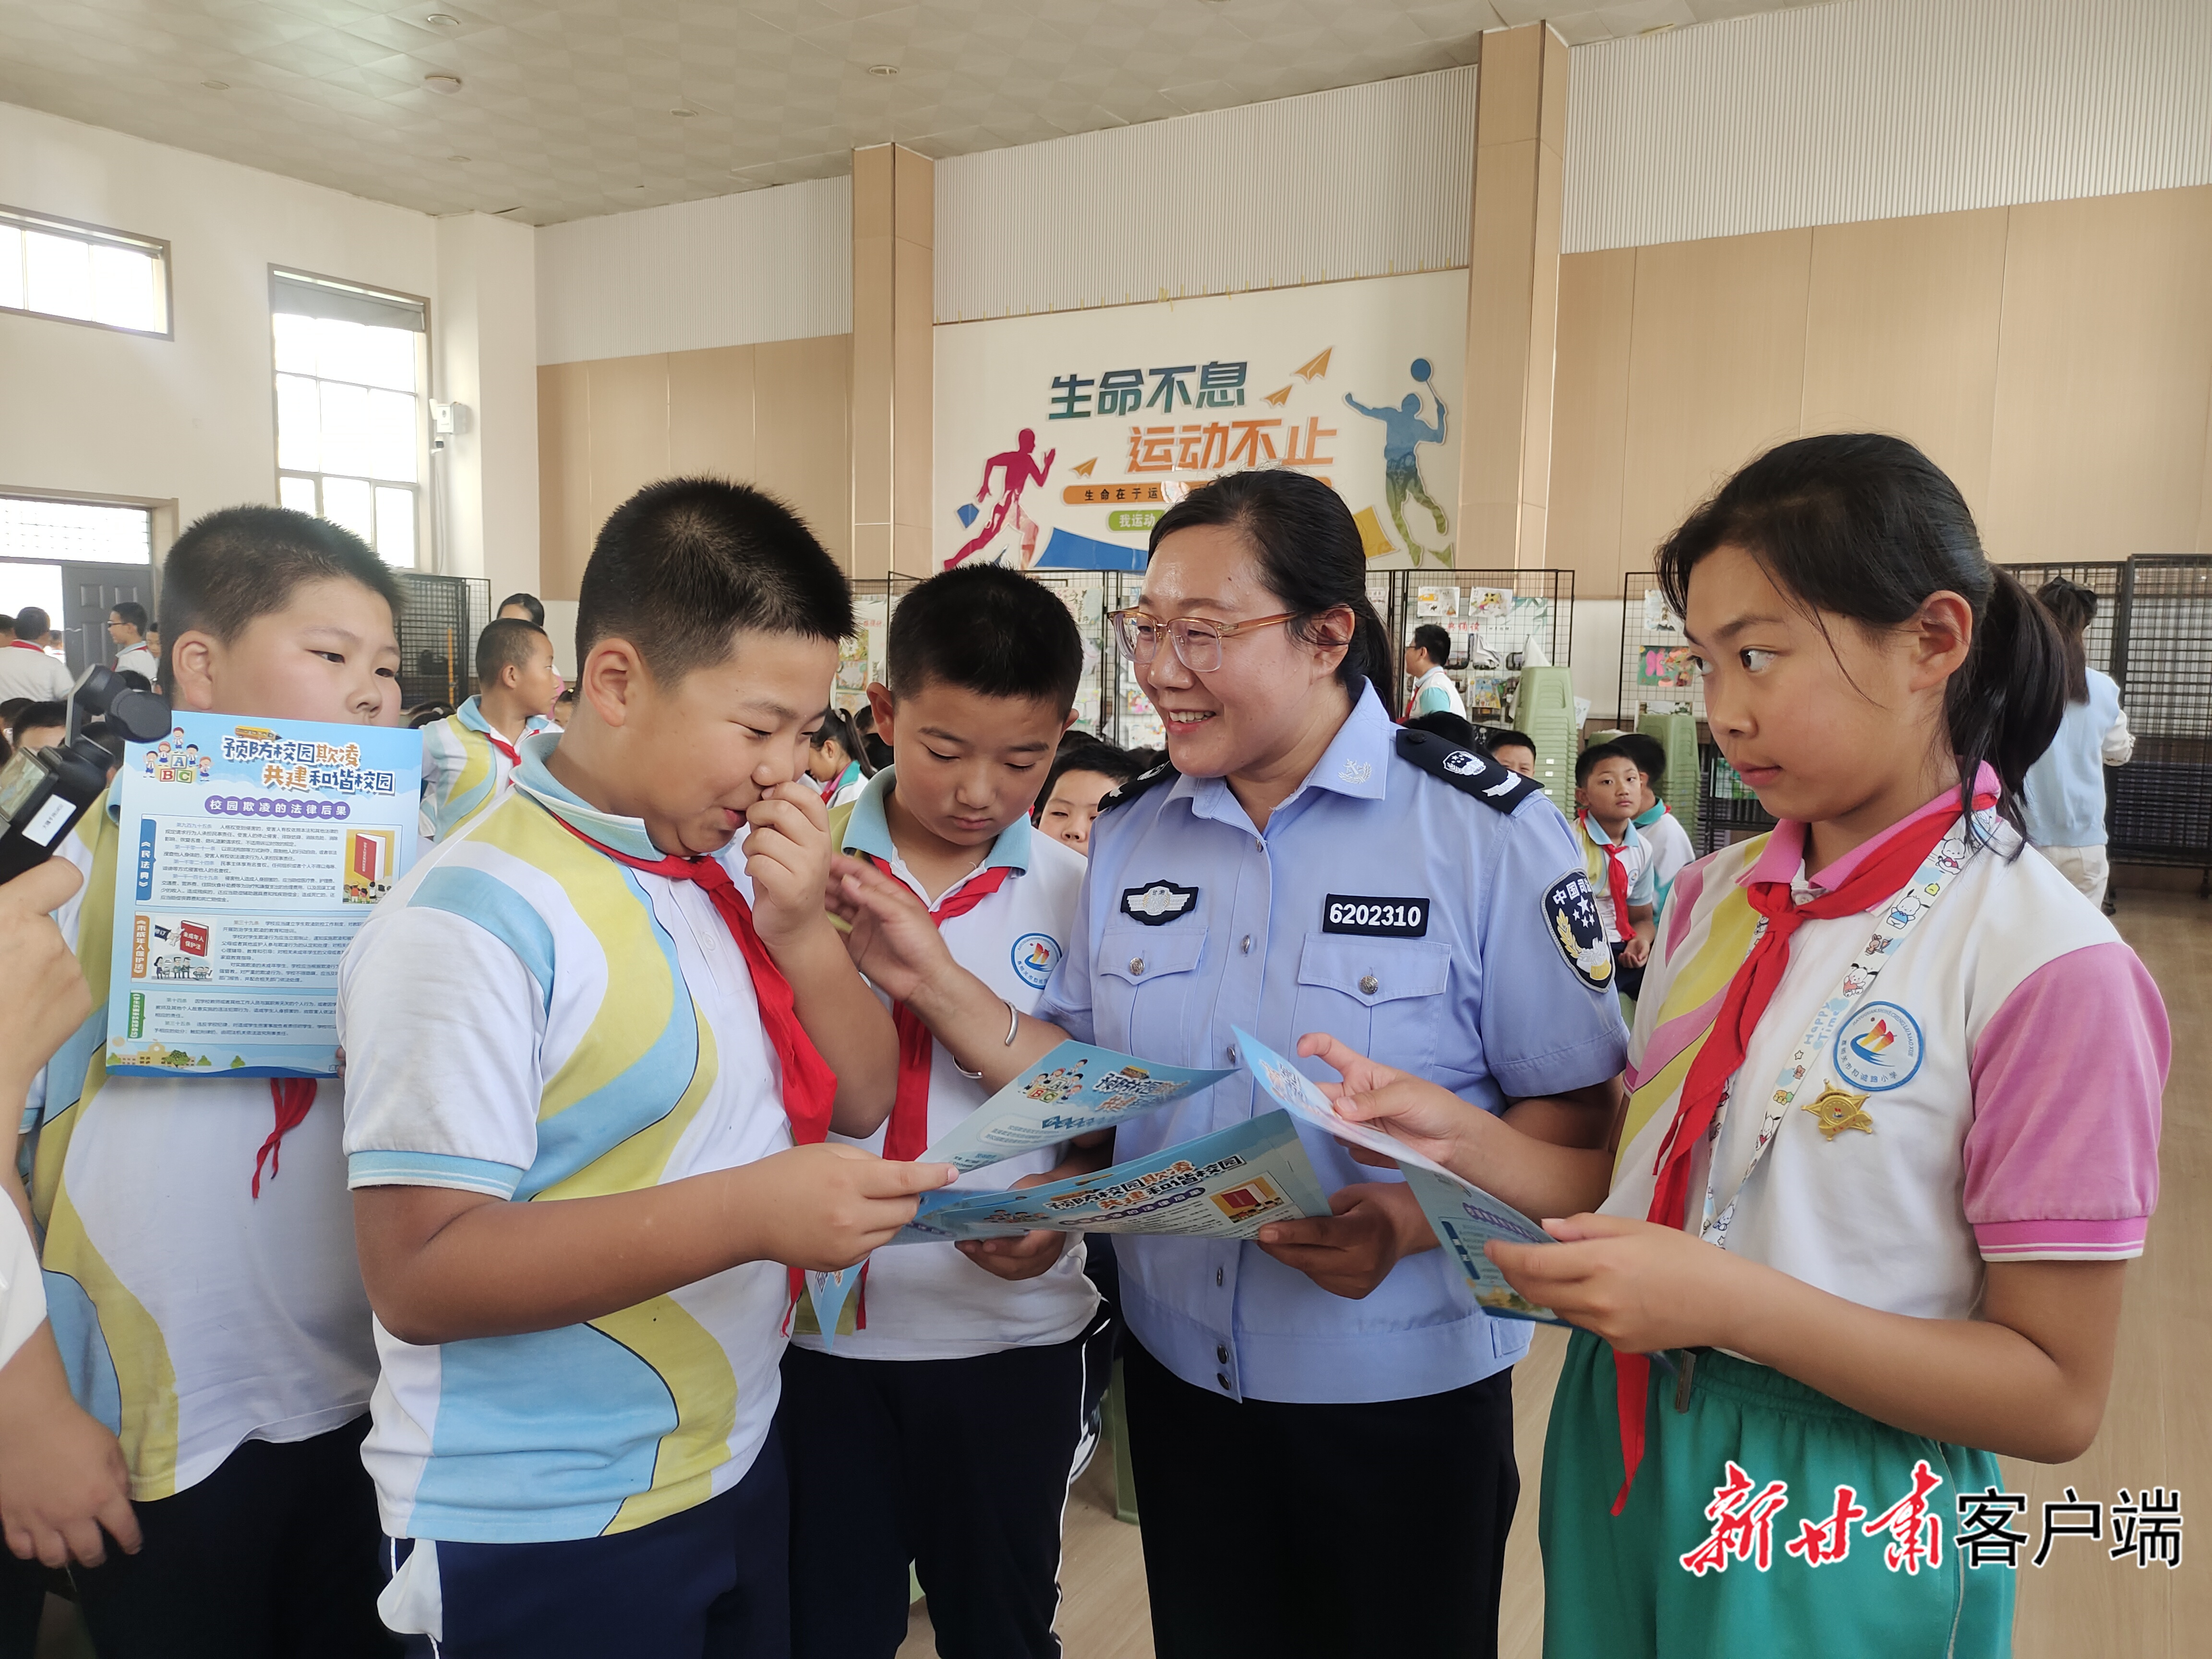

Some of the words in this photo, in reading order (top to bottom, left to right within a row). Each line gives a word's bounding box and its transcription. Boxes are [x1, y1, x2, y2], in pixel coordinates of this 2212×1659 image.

[1048, 361, 1247, 420] 生命不息
[1127, 417, 1338, 473] 运动不止
[1085, 488, 1157, 501] 生命在于运
[1119, 513, 1155, 528] 我运动
[173, 757, 184, 767] A
[223, 737, 360, 768] 预防校园欺凌
[162, 770, 172, 780] B
[179, 771, 190, 781] C
[264, 765, 393, 792] 共建和谐校园
[210, 798, 347, 817] 校园欺凌的法律后果
[1329, 903, 1421, 927] 6202310
[1803, 1002, 1830, 1045] Happy
[1817, 1010, 1840, 1041] Time
